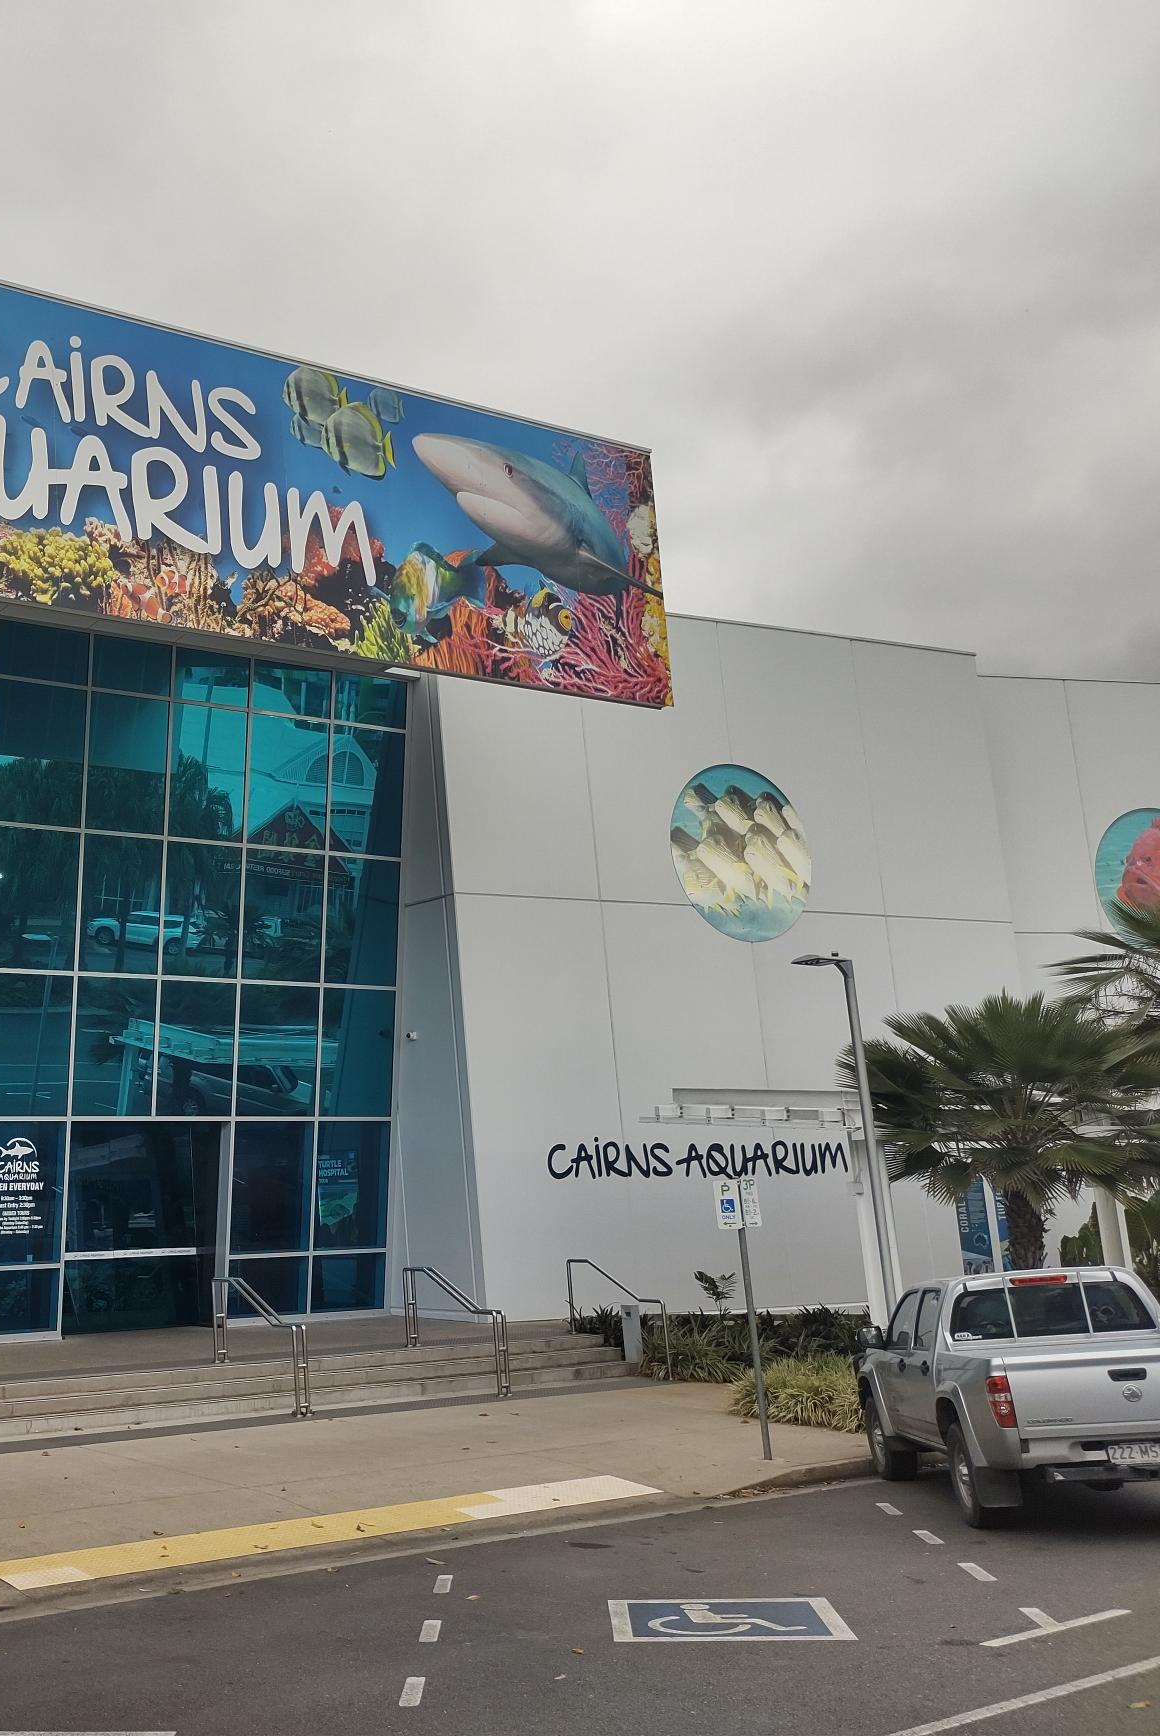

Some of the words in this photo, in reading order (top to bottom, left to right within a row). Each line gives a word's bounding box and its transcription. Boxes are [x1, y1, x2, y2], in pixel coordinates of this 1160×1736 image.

[318, 1160, 342, 1168] TURTLE
[675, 1140, 848, 1179] AQUARIUM
[318, 1168, 349, 1177] HOSPITAL
[9, 1182, 44, 1191] EVERYDAY
[720, 1184, 730, 1197] P
[742, 1179, 755, 1190] 3P
[957, 1201, 969, 1233] CORAL
